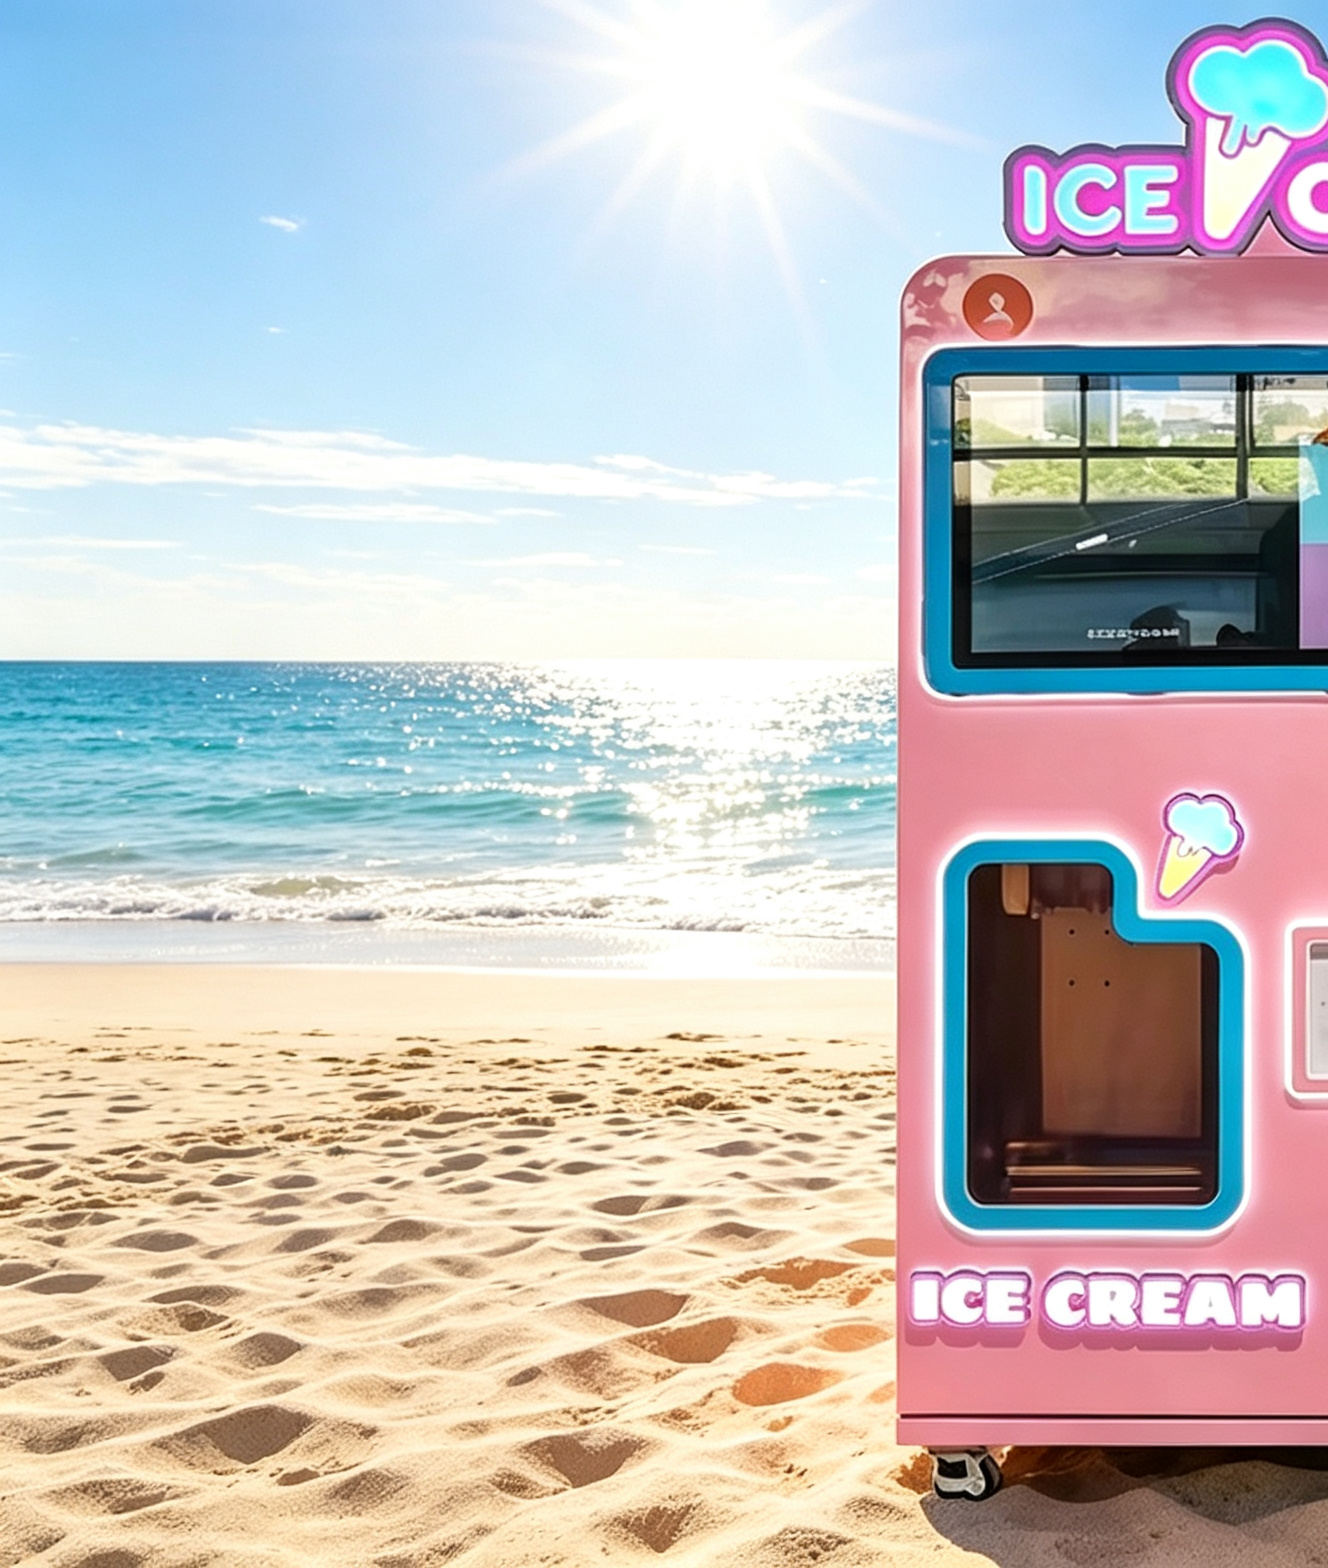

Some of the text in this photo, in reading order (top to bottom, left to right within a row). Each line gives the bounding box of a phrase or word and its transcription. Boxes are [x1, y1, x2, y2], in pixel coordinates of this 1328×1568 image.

[1022, 162, 1179, 236] ICE
[910, 1275, 1303, 1328] ICE CREAM
